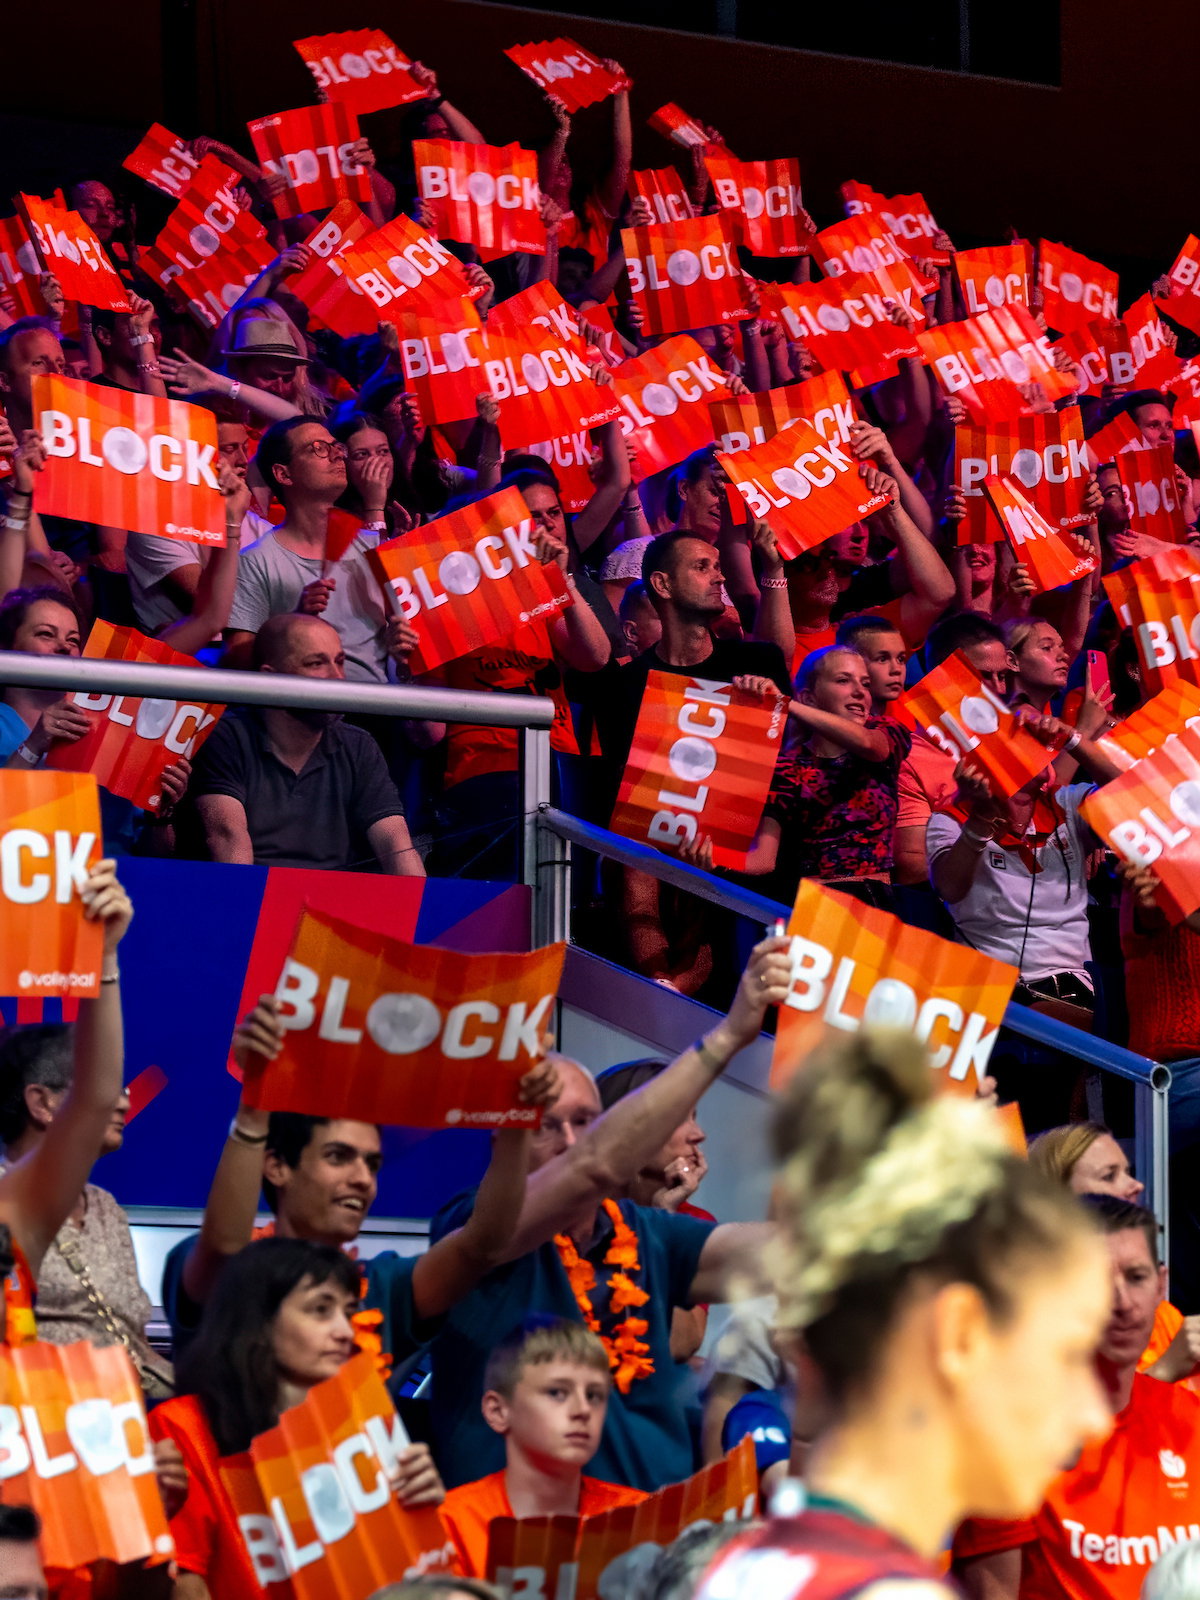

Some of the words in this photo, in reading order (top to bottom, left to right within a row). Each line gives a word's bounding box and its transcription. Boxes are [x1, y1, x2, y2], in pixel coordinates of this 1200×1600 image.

[356, 235, 452, 307] BLOCK
[627, 242, 742, 293] BLOCK
[484, 347, 592, 400] BLOCK
[41, 409, 222, 490] BLOCK
[736, 442, 854, 519] BLOCK
[177, 525, 223, 542] volleybal
[384, 518, 540, 622] BLOCK
[647, 677, 732, 847] BLOCK
[274, 957, 555, 1062] BLOCK
[783, 934, 1001, 1082] BLOCK
[239, 1413, 412, 1589] BLOCK
